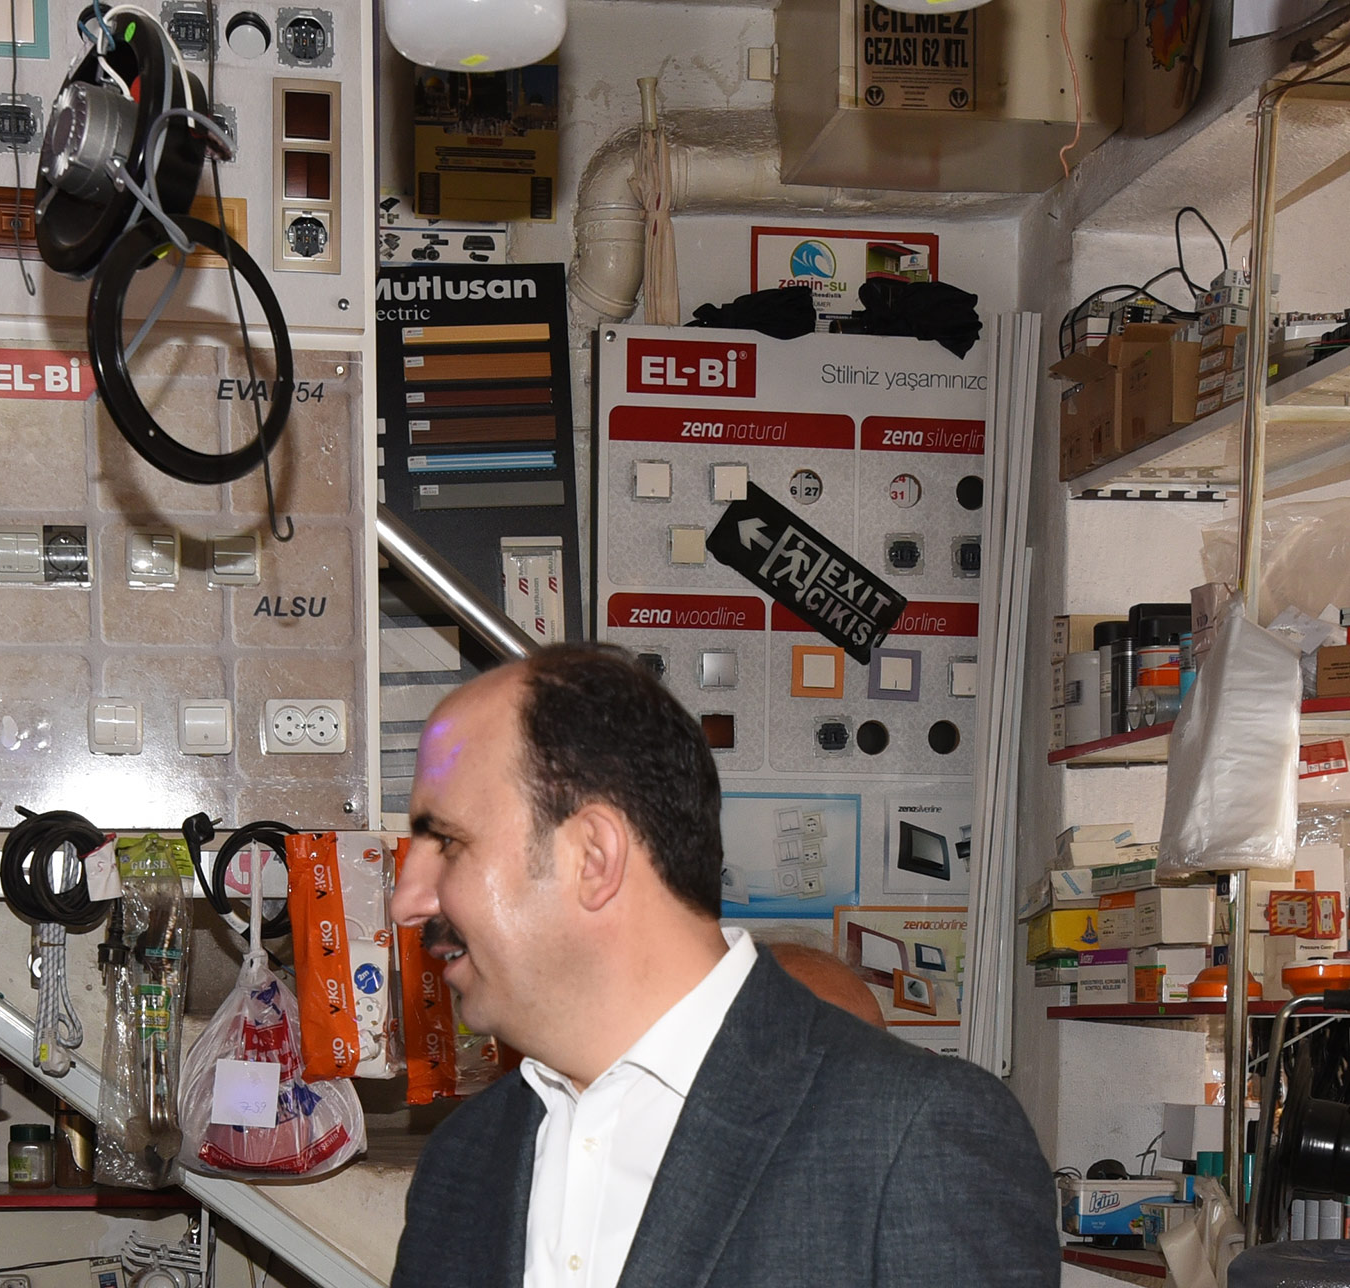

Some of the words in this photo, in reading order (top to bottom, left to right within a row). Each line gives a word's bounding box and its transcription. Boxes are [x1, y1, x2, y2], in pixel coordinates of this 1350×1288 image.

[864, 37, 917, 66] CEZASI
[922, 38, 939, 67] 62
[376, 304, 431, 321] ectric
[821, 363, 880, 385] Stiliniz
[681, 421, 724, 438] zena
[726, 421, 788, 441] natural
[882, 428, 924, 447] zena
[804, 486, 820, 497] 27
[891, 490, 906, 500] 31
[822, 558, 892, 618] EXIT
[253, 597, 327, 618] ALSU
[629, 608, 672, 625] zena
[674, 606, 746, 627] woodline
[890, 612, 947, 633] olorline
